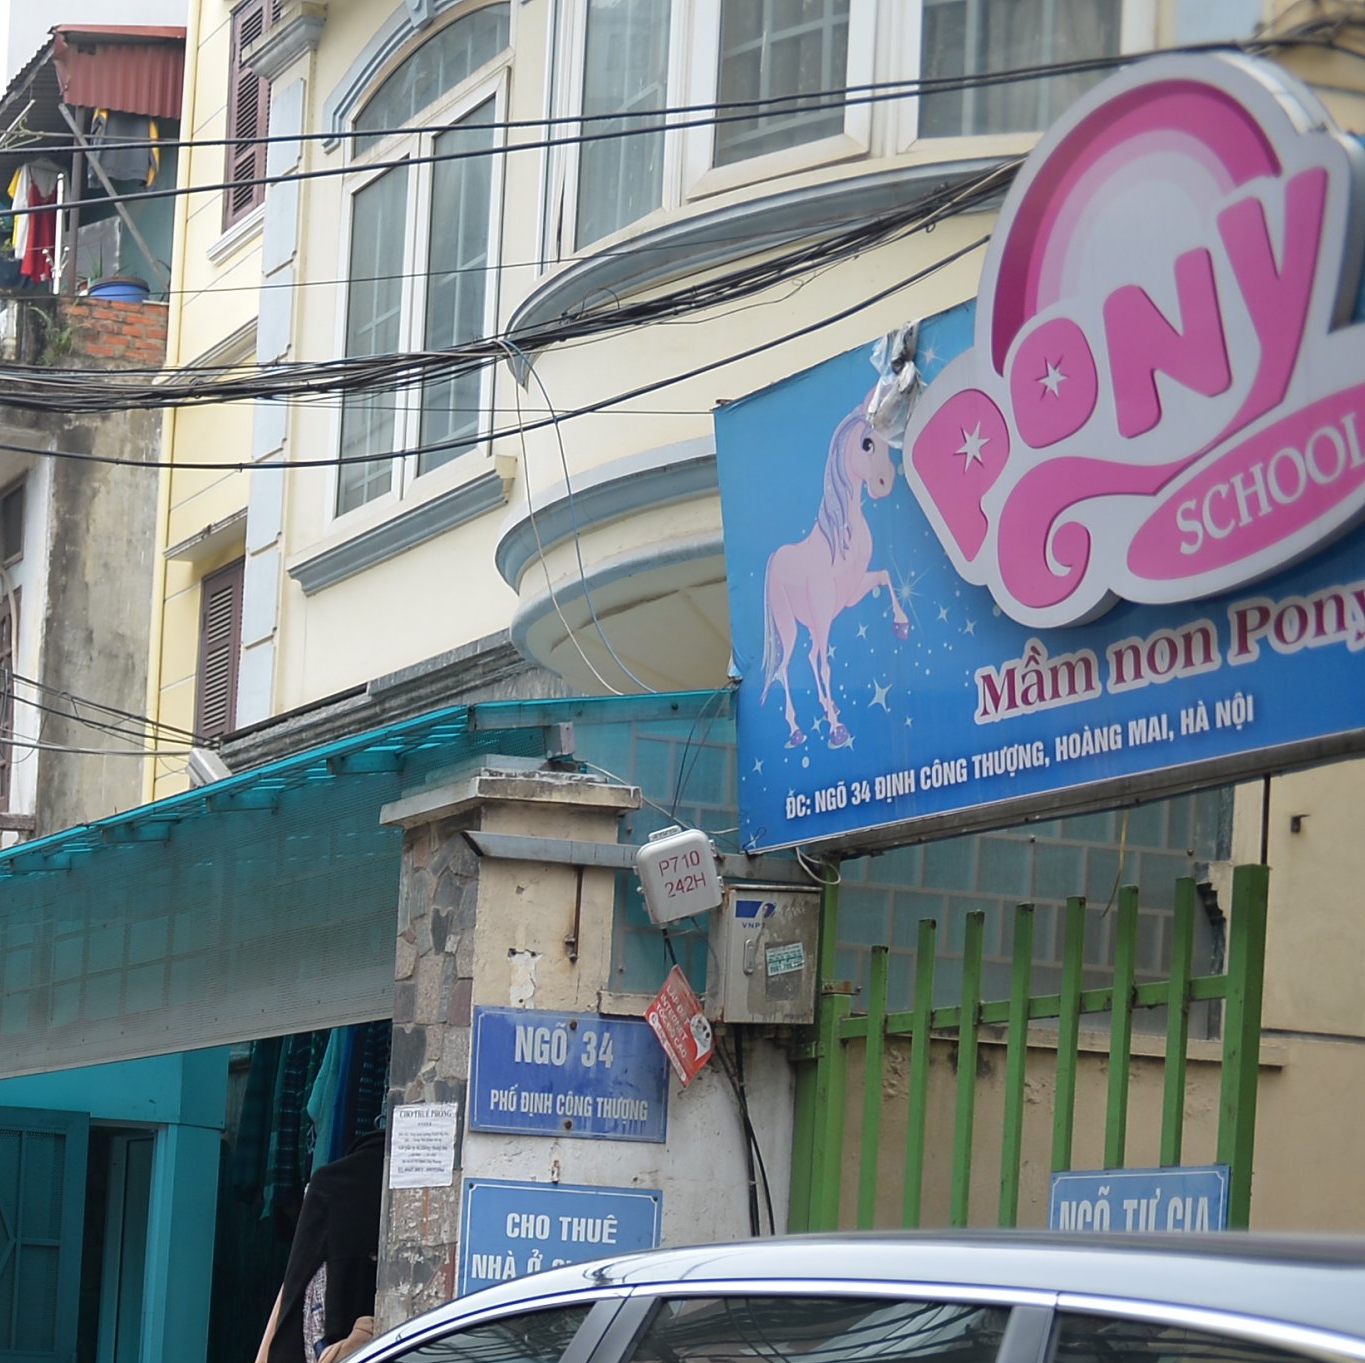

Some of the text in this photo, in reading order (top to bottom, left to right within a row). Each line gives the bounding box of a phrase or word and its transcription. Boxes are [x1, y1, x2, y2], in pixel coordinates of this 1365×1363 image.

[911, 166, 1329, 608] PONY
[980, 645, 1093, 720] Mầm
[1114, 631, 1214, 687] non
[785, 694, 1255, 821] ĐC: NGÕ 34 ĐỊNH CÔNG THƯỢNG, HOÀNG MAI, HÀ NỘI
[658, 850, 701, 877] P710
[665, 873, 707, 898] 242H
[515, 1022, 614, 1069] NGÕ 34
[489, 1083, 649, 1122] PHỐ ĐỊNH CÔNG THƯỢNG
[506, 1213, 618, 1244] CHO THUÊ
[471, 1251, 517, 1280] NHÀ
